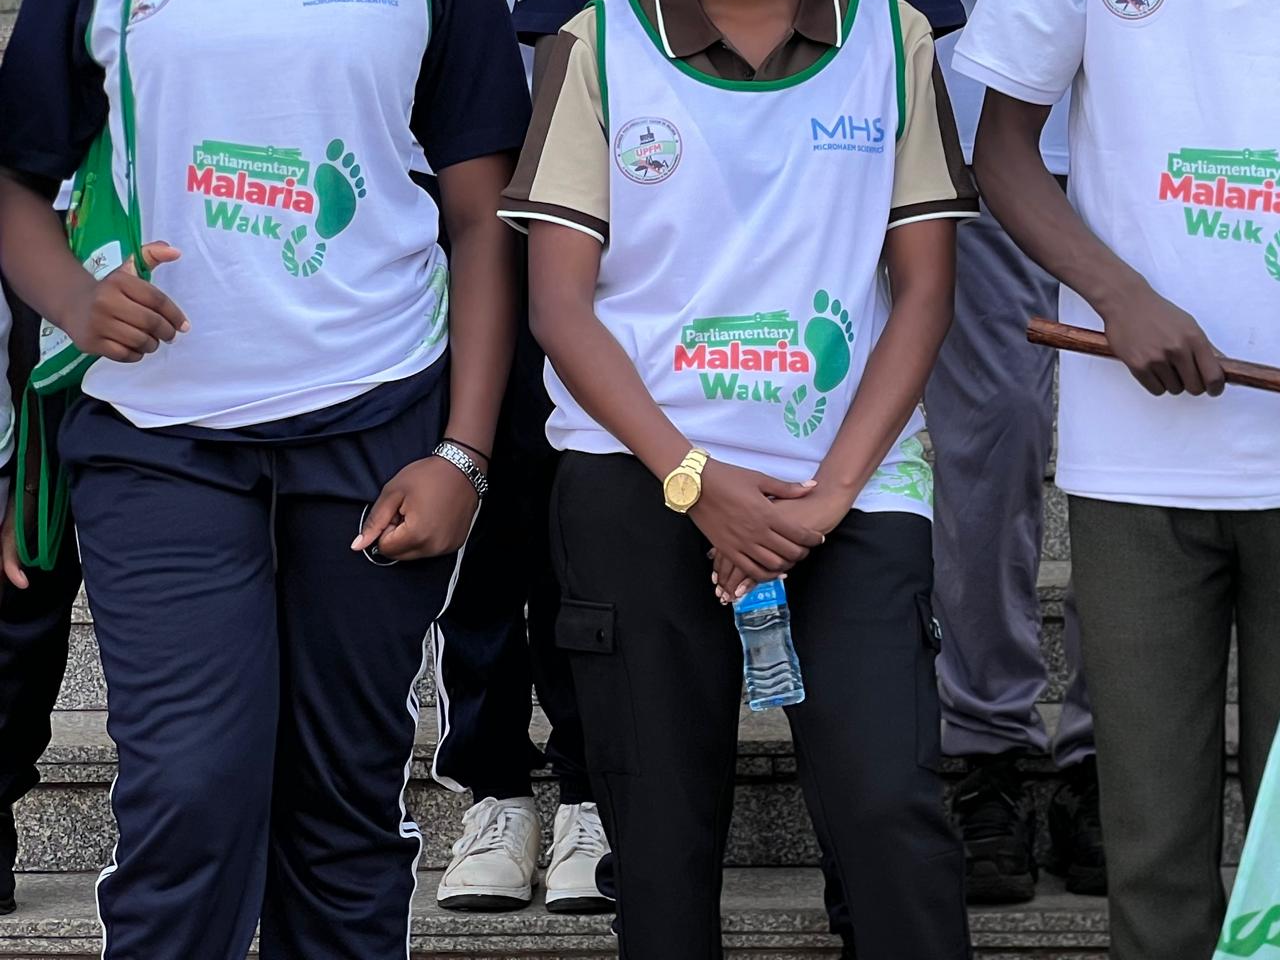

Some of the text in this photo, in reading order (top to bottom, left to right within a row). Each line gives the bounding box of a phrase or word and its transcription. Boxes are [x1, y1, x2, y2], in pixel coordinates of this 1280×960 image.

[810, 115, 885, 143] MHS
[195, 150, 305, 177] Parliamentary
[636, 143, 662, 157] UPFM
[187, 165, 314, 215] Malaria
[204, 198, 283, 240] Walk
[1183, 206, 1264, 244] Walk
[685, 326, 795, 343] Parliamentary
[674, 340, 810, 373] Malaria
[698, 372, 784, 404] Walk
